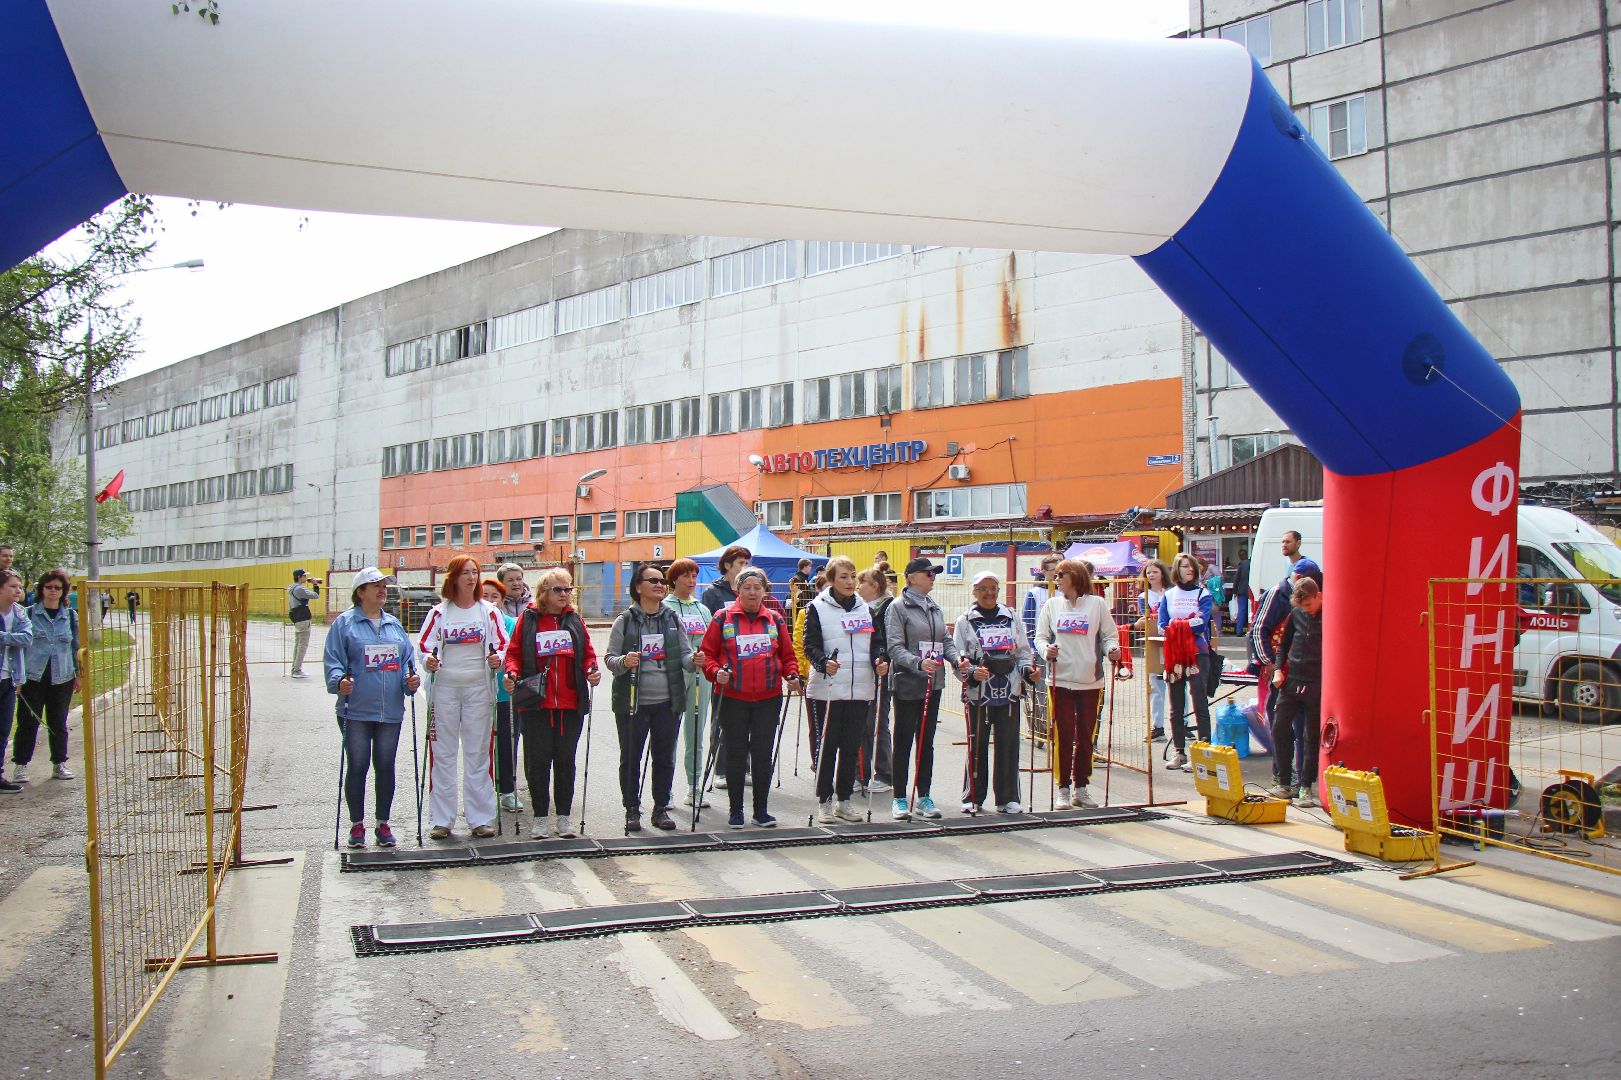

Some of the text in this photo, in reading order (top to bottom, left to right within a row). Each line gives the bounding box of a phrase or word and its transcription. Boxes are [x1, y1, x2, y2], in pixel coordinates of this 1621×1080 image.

[761, 440, 927, 473] АВТОТЕХЦЕНТР
[656, 547, 661, 557] 2
[841, 619, 869, 629] 1475
[1056, 619, 1088, 628] 1467
[444, 627, 476, 639] 1463
[1439, 462, 1515, 811] ФИНИШ
[536, 639, 569, 652] 1462
[979, 635, 1009, 645] 1474
[737, 642, 769, 655] 1465
[365, 653, 396, 666] 1472
